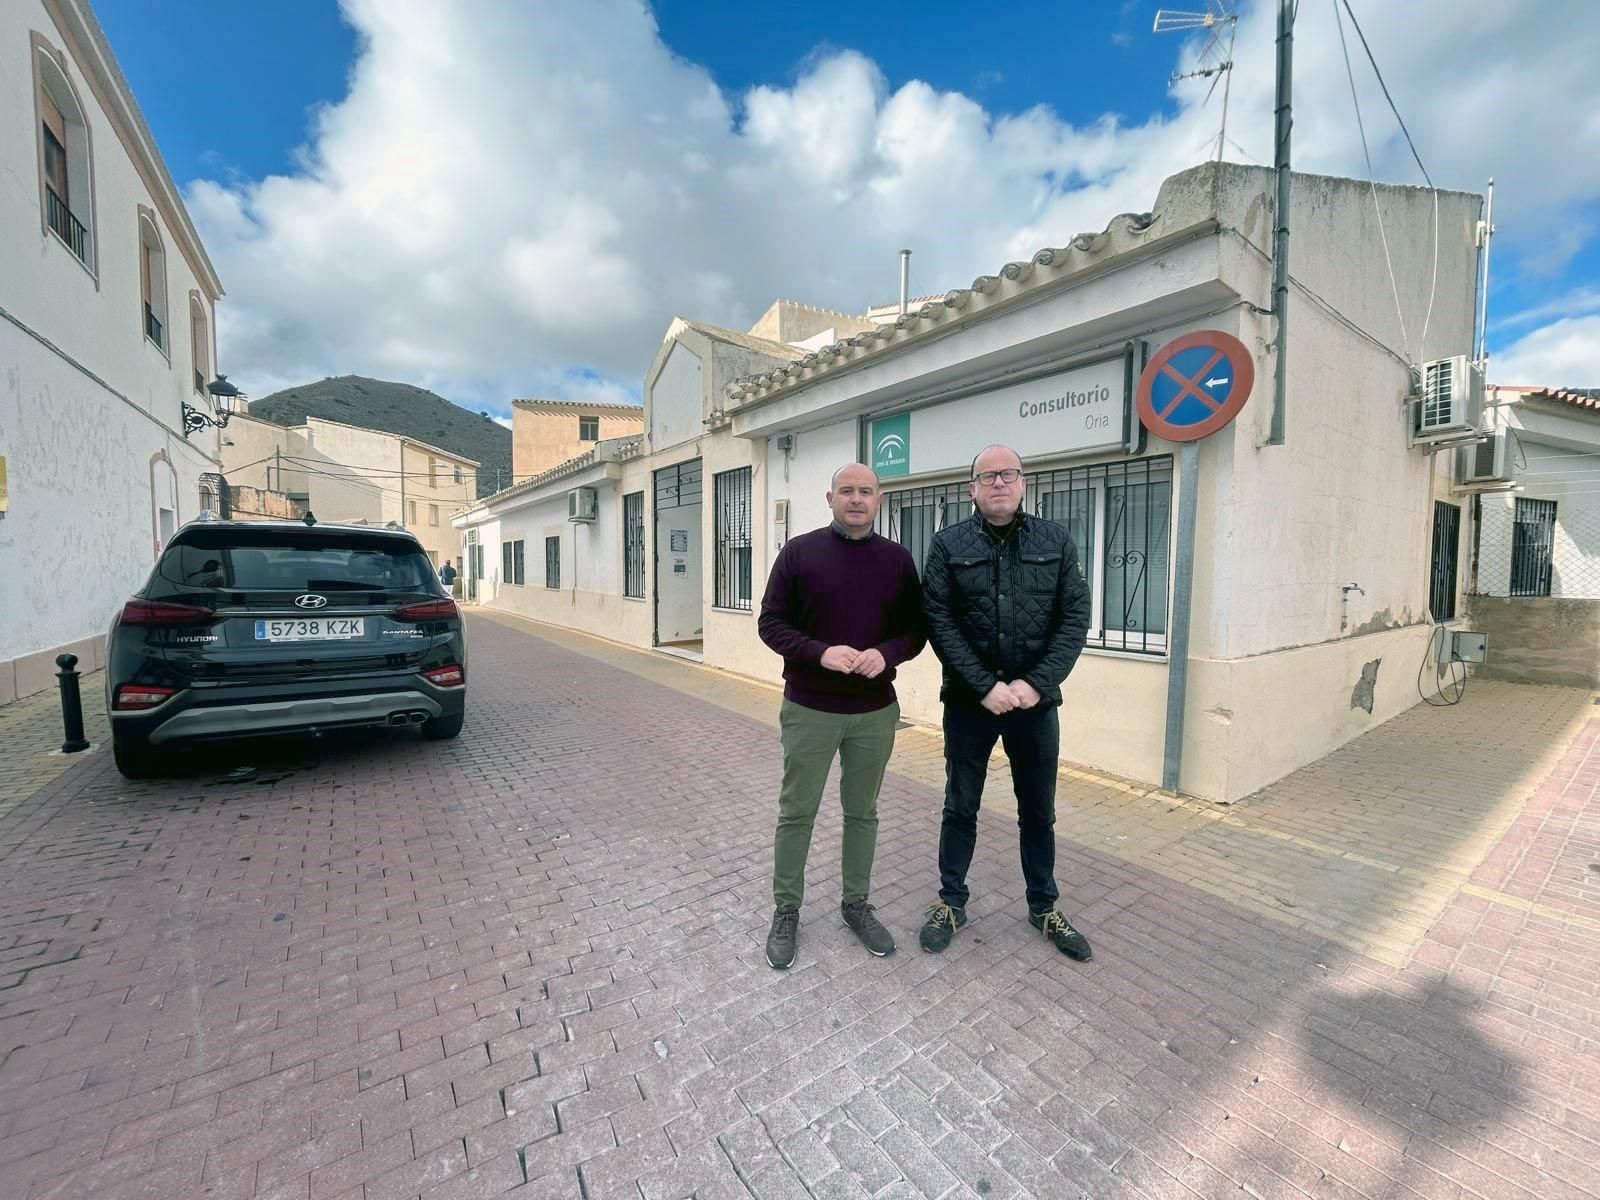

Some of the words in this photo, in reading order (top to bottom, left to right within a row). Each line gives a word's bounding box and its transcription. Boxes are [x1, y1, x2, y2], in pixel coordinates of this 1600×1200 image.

[1019, 384, 1110, 418] Consultorio
[1085, 413, 1109, 430] Oria
[271, 621, 320, 637] 5738
[326, 619, 360, 635] KZK
[176, 635, 218, 643] HYUNDAI
